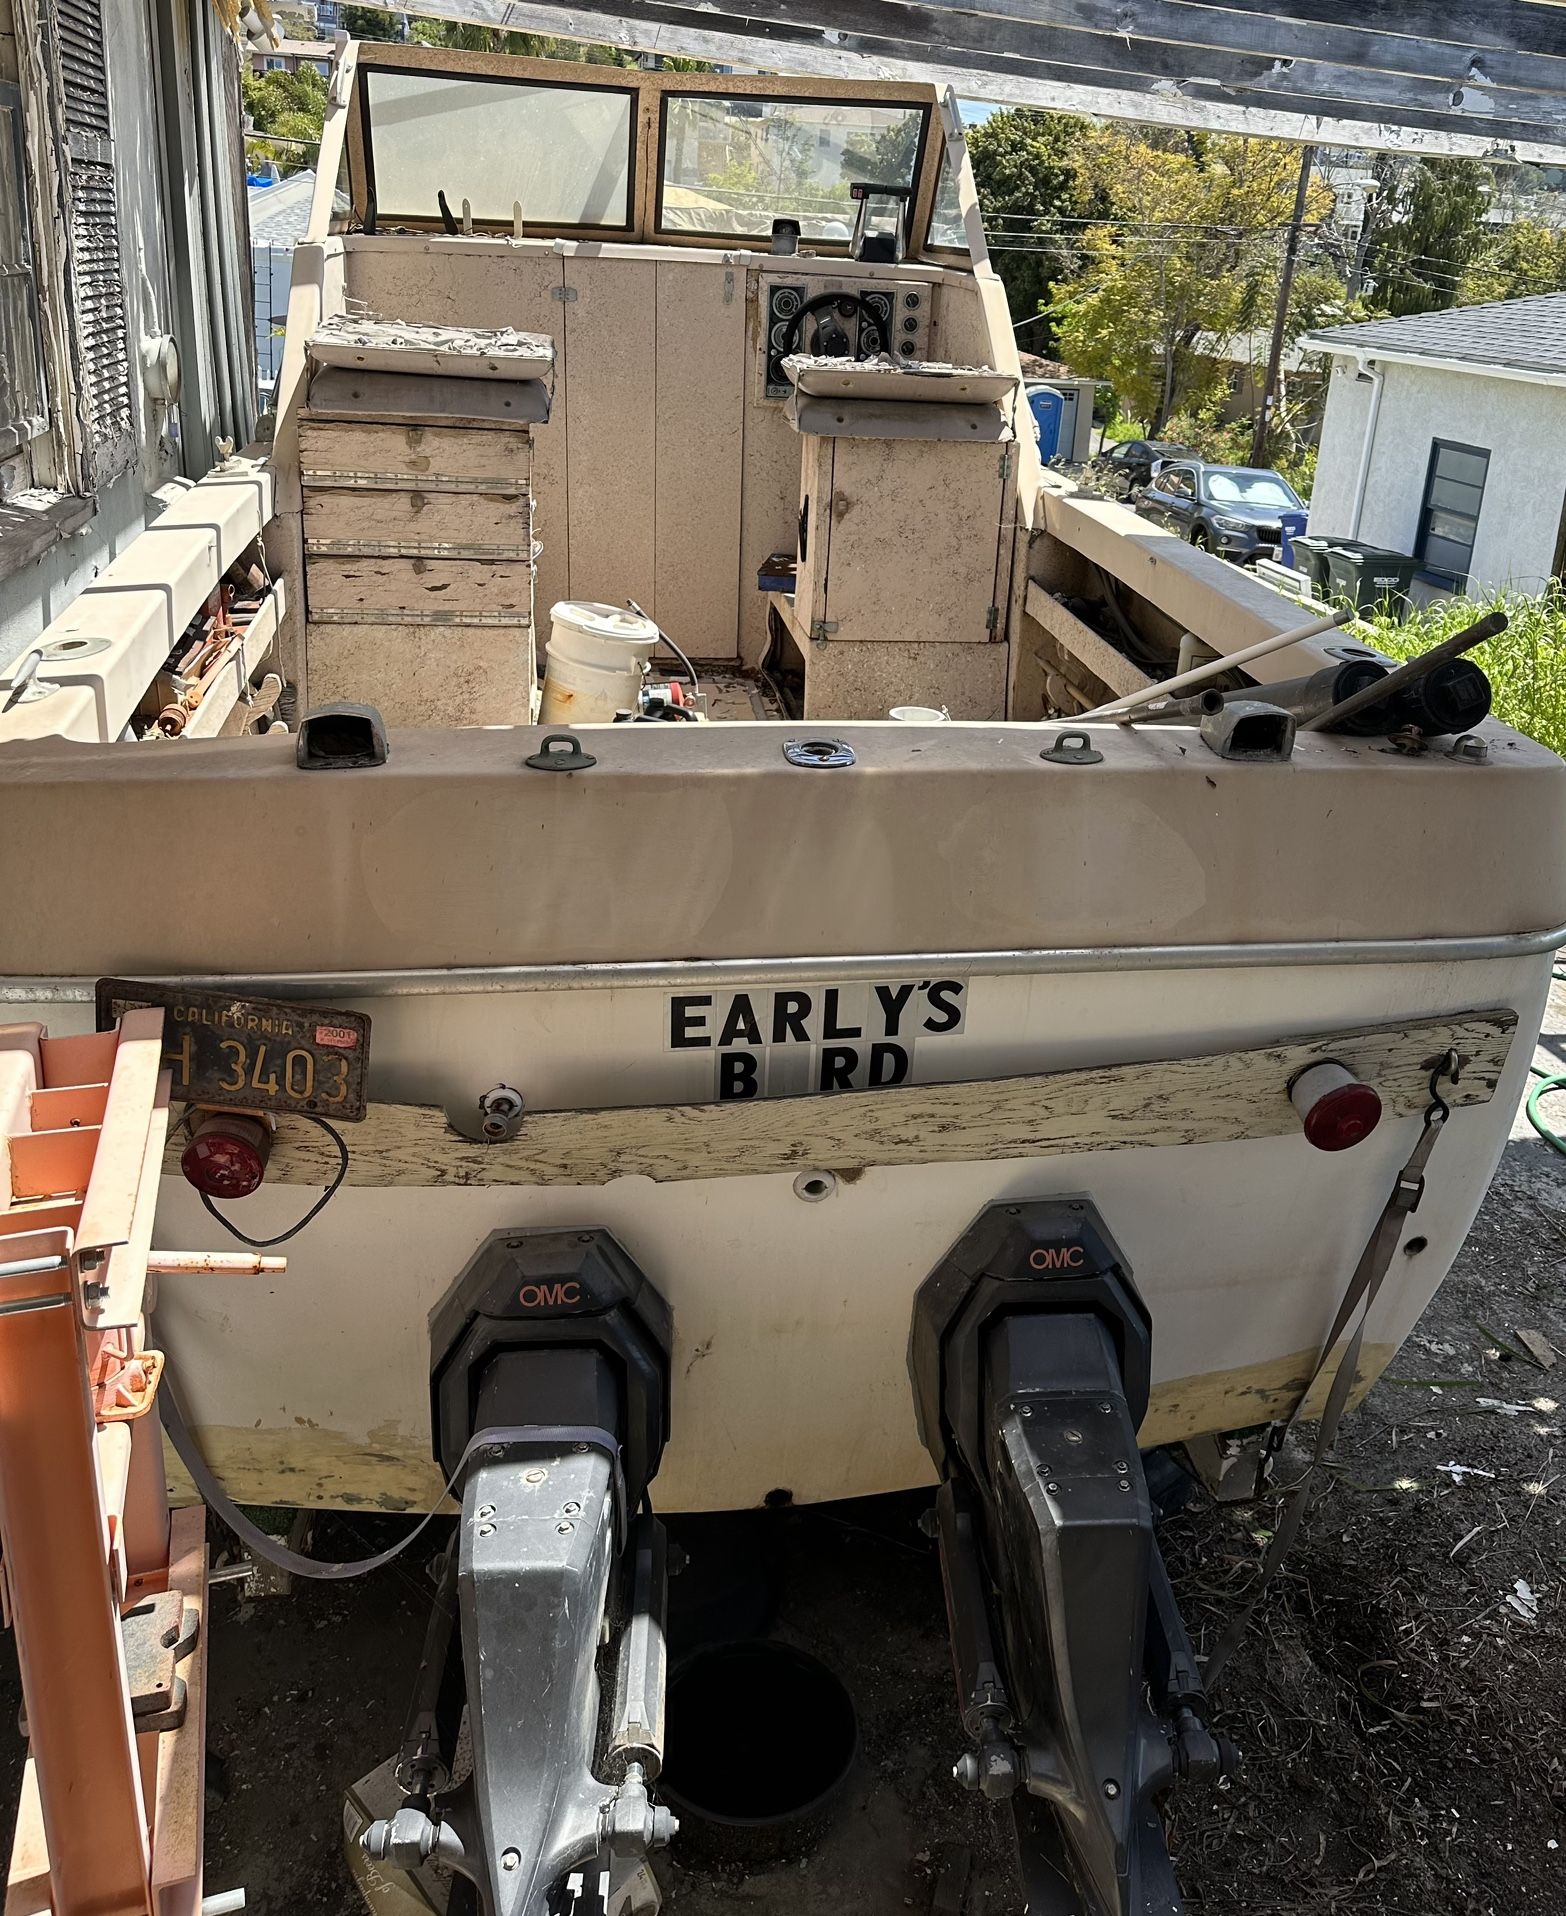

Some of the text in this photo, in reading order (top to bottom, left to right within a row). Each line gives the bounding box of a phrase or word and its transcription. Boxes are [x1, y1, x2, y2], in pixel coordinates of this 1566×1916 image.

[173, 1006, 293, 1035] CALIFORNIA
[670, 980, 964, 1048] EARLY'S
[219, 1040, 349, 1104] 3403
[1029, 1246, 1084, 1269] OMC
[520, 1282, 581, 1307] OMC
